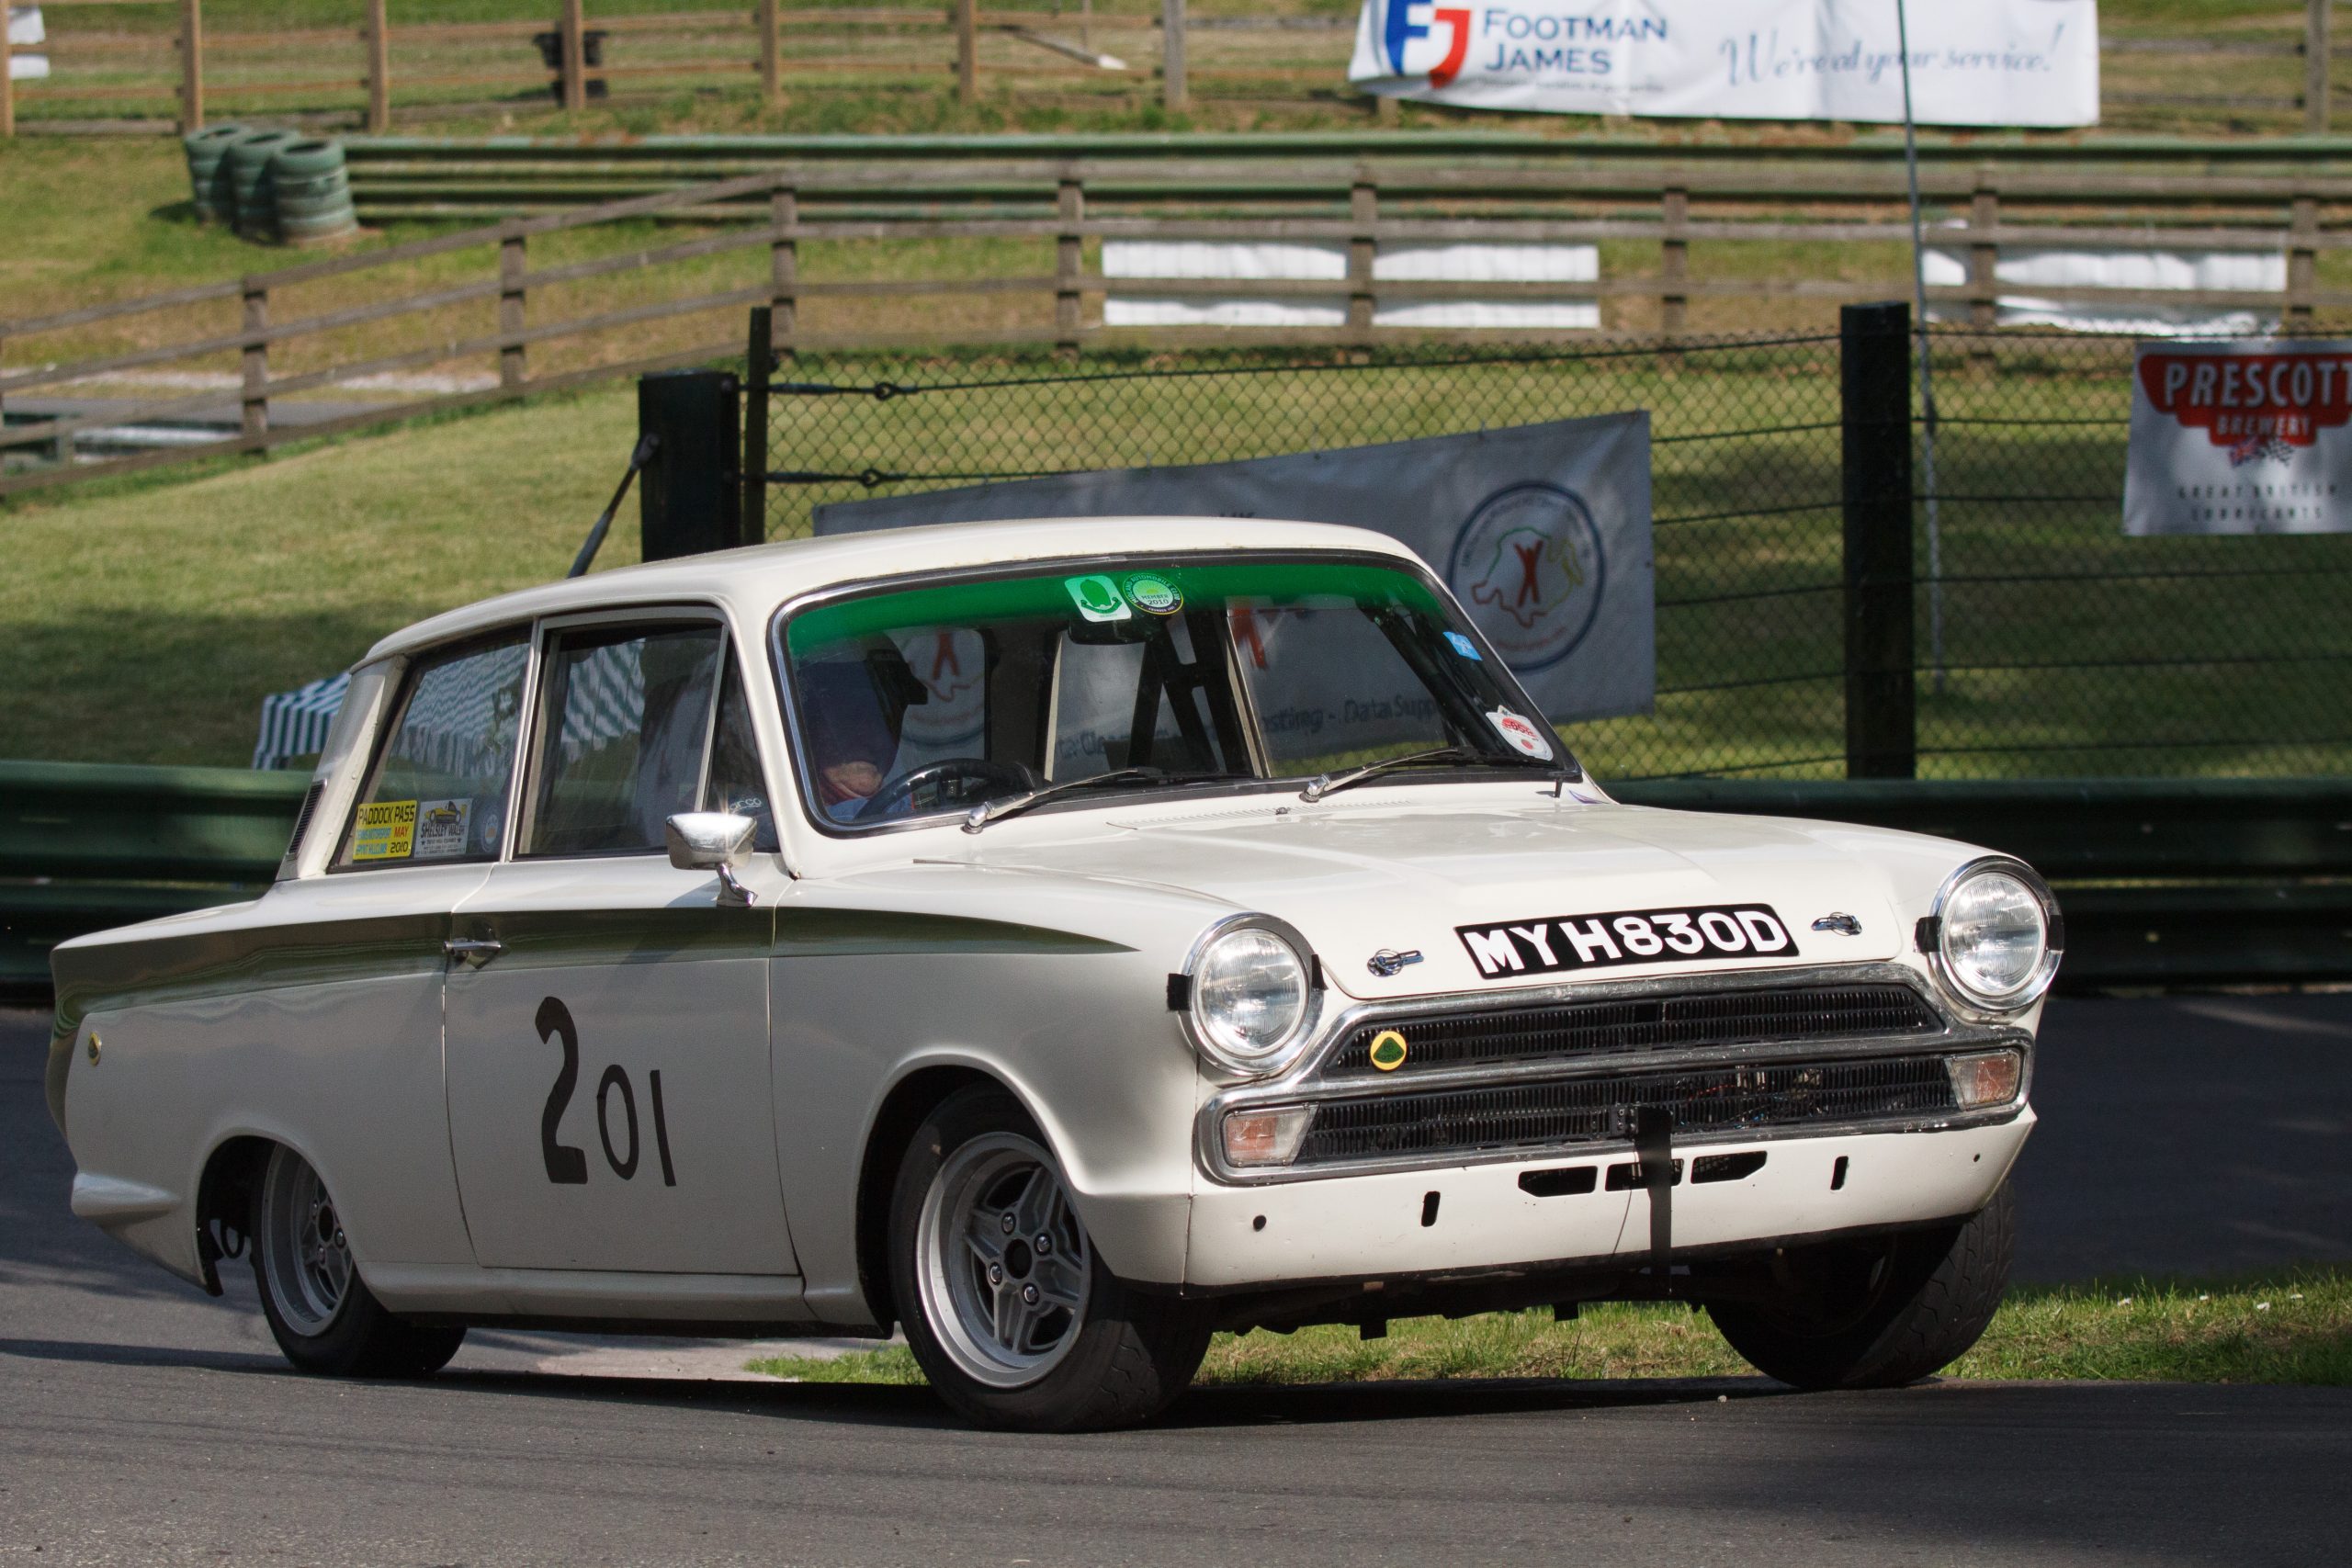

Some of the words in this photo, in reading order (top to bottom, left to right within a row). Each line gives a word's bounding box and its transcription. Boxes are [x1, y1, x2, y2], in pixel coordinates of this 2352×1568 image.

[1483, 8, 1668, 41] FOOTMAN
[1485, 44, 1611, 74] JAMES
[2216, 414, 2310, 437] BREWERY
[1130, 574, 1171, 588] AUTOMOBILE
[358, 807, 393, 825] PADDOCK
[394, 805, 415, 823] PASS
[394, 826, 410, 838] MAY
[421, 822, 447, 839] SHELSLEY
[448, 823, 465, 836] WALSH
[390, 840, 409, 852] 2010
[535, 996, 677, 1187] 201
